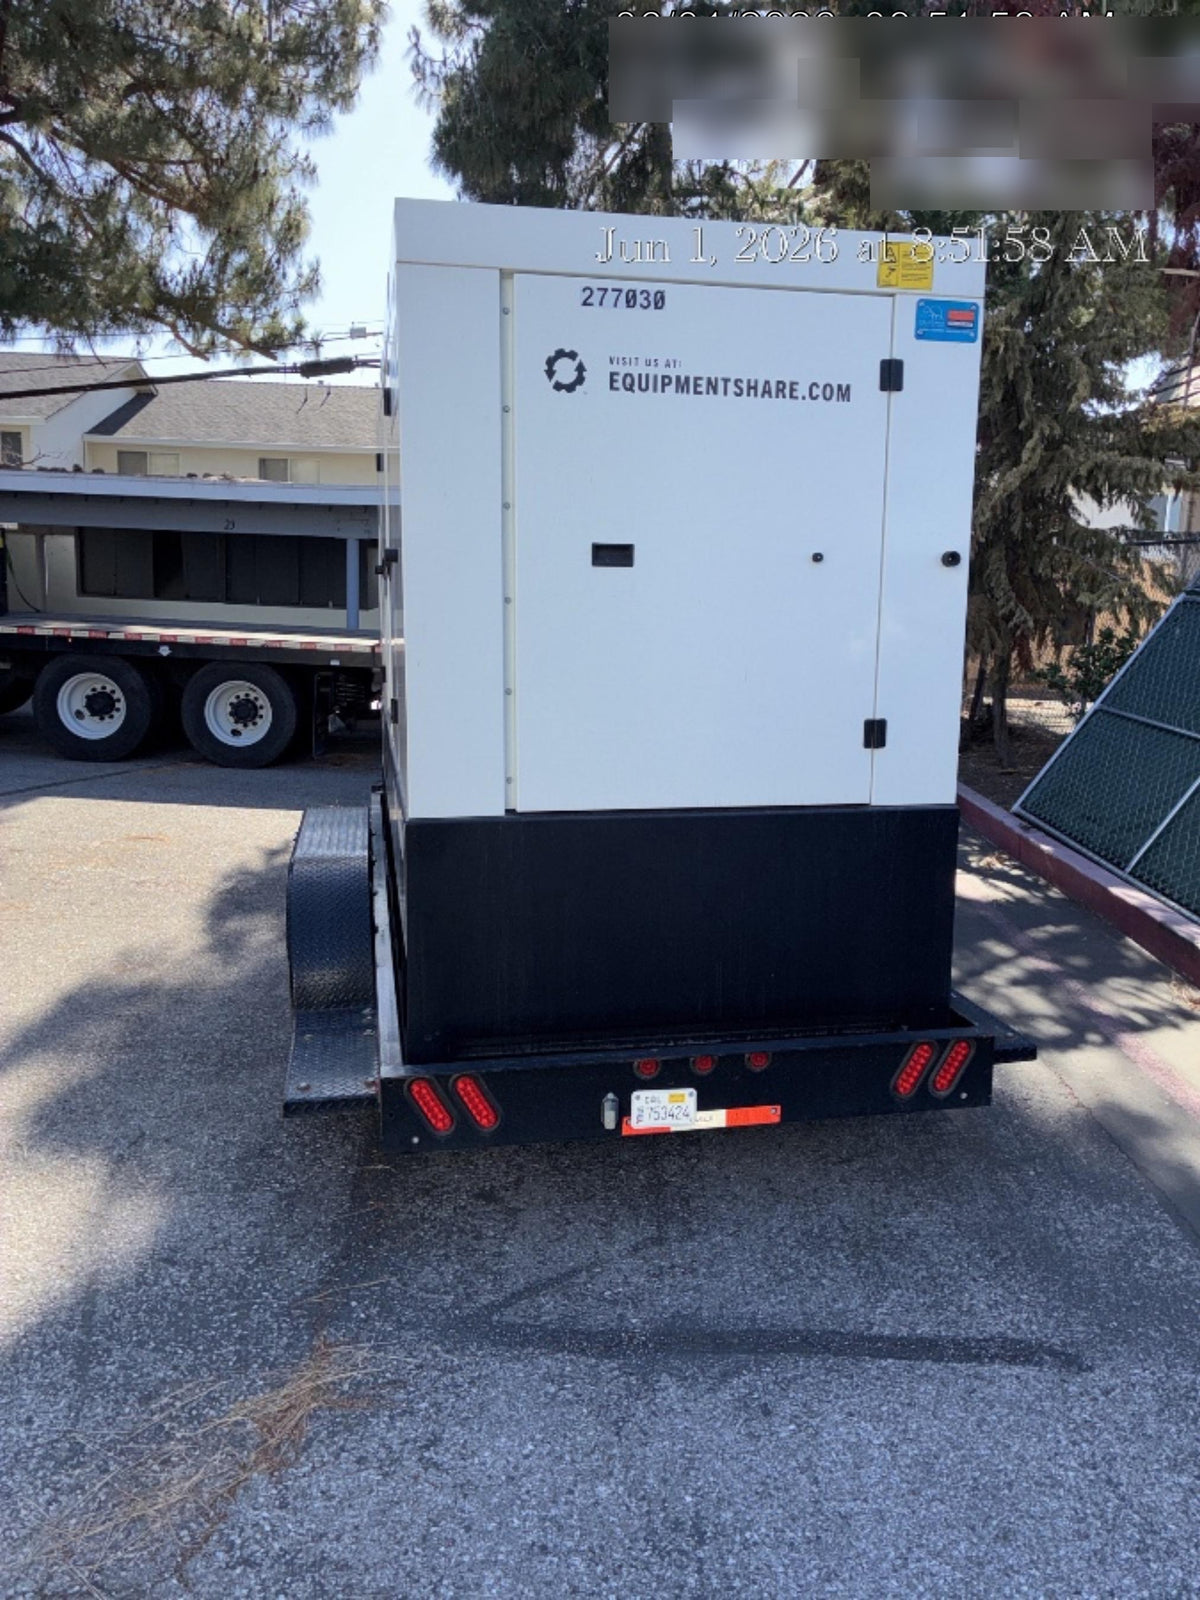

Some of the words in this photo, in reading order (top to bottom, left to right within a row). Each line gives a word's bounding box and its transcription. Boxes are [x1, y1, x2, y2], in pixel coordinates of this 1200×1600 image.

[581, 286, 665, 310] 277030
[609, 356, 639, 367] VISIT
[645, 358, 659, 368] US
[664, 358, 682, 369] AT:
[609, 371, 851, 402] EQUIPMENTSHARE.COM
